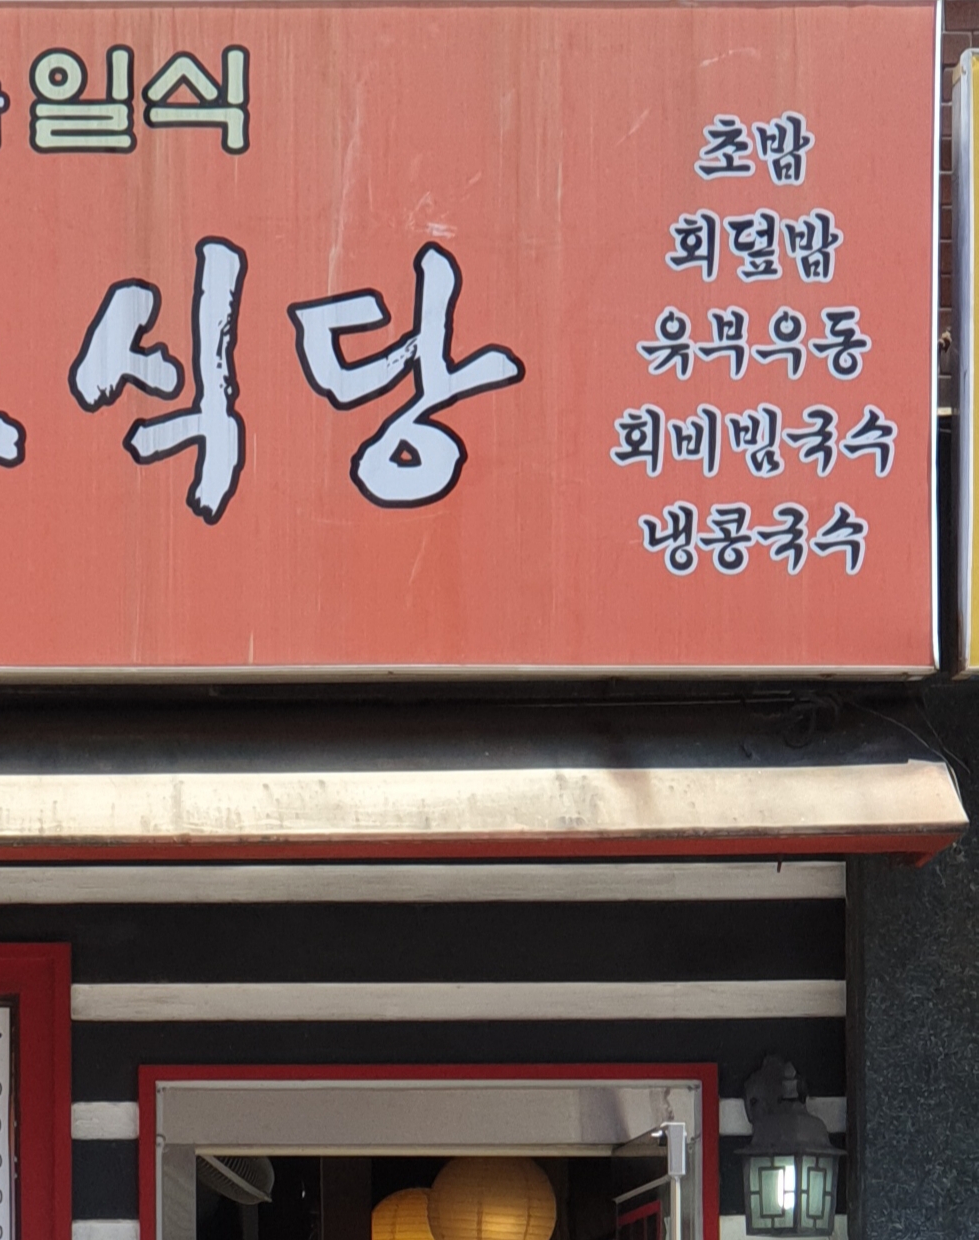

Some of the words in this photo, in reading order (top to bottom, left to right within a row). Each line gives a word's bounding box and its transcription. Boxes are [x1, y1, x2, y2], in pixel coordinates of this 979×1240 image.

[29, 44, 250, 154] 일식
[693, 111, 813, 185] 초밥
[666, 209, 842, 283] 회덮밥
[610, 405, 897, 477] 회비빔국수
[640, 500, 868, 574] 냉콩국수
